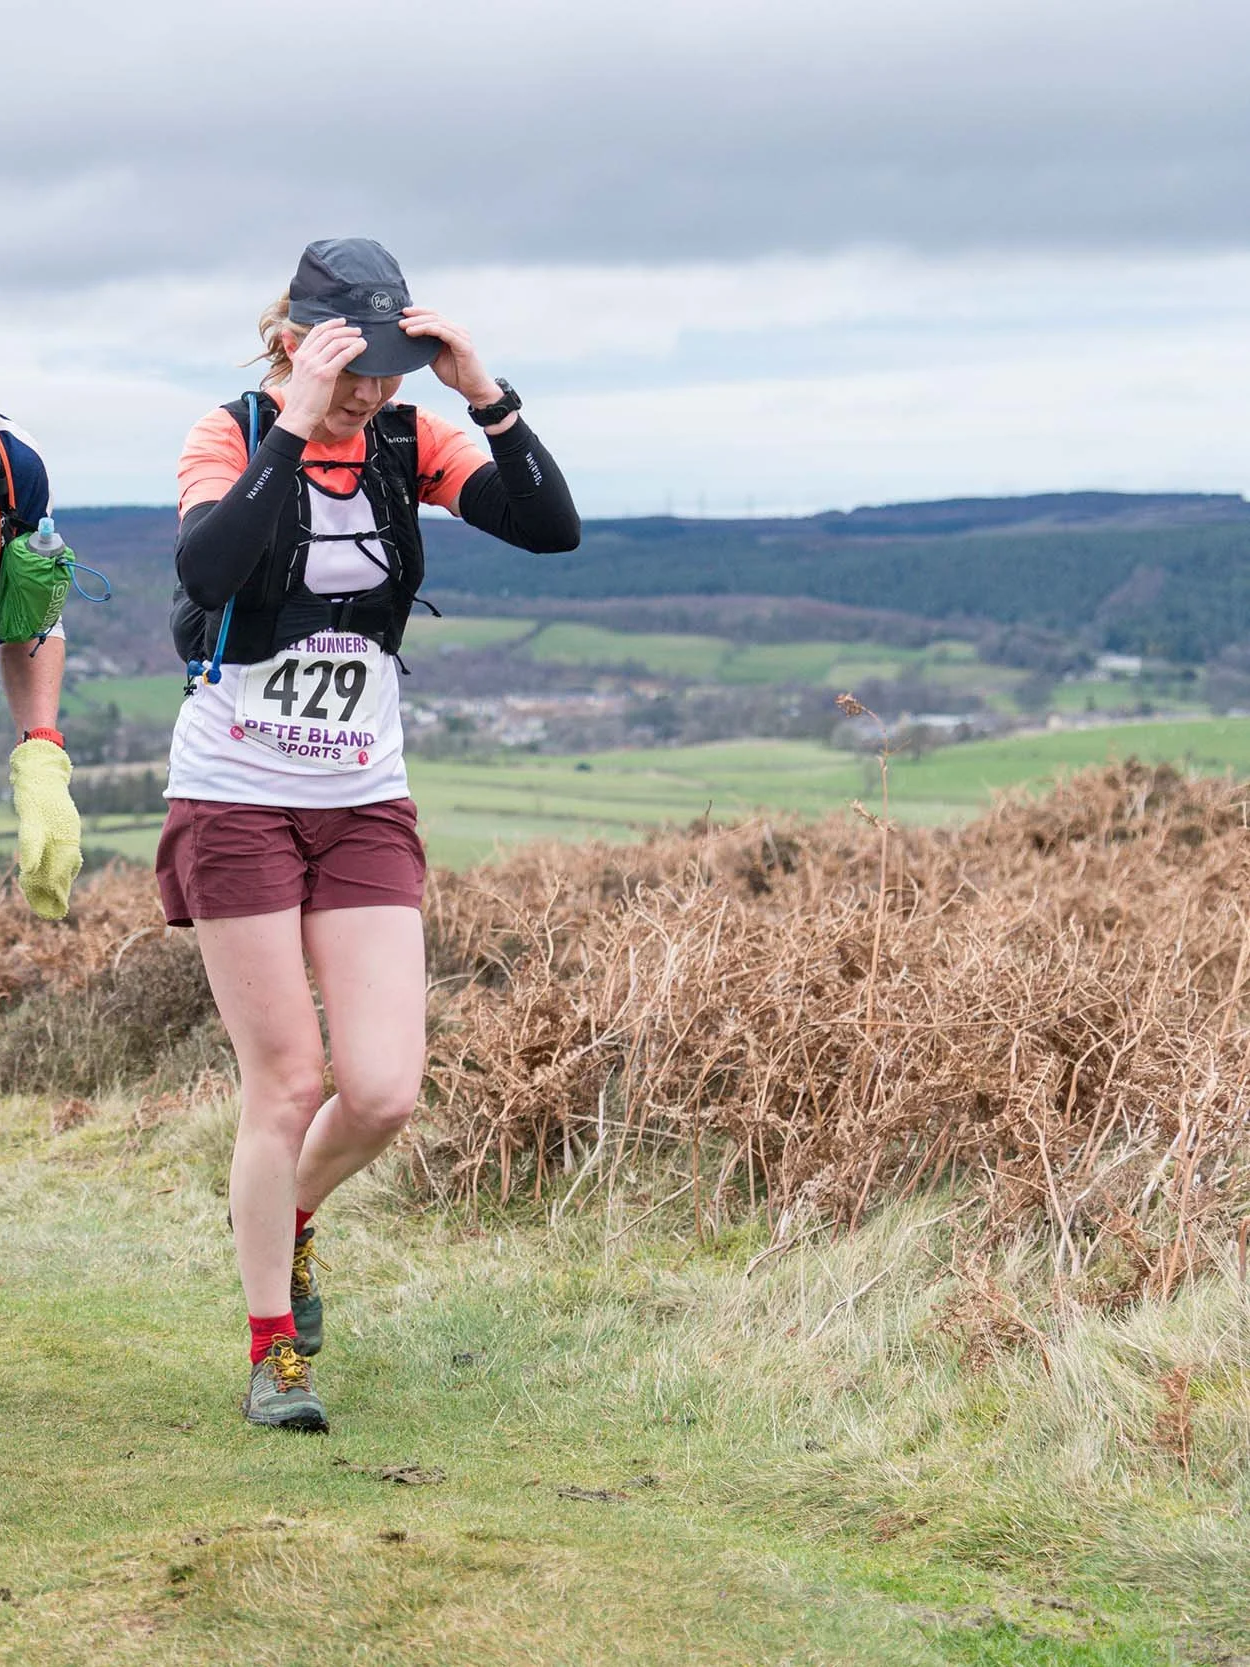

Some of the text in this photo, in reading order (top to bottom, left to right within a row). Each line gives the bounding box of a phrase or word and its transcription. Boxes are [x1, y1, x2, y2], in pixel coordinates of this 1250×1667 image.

[306, 637, 368, 653] RUNNERS
[263, 658, 367, 722] 429
[244, 719, 301, 741] PETE
[308, 727, 375, 747] BLAND
[278, 742, 342, 760] SPORTS
